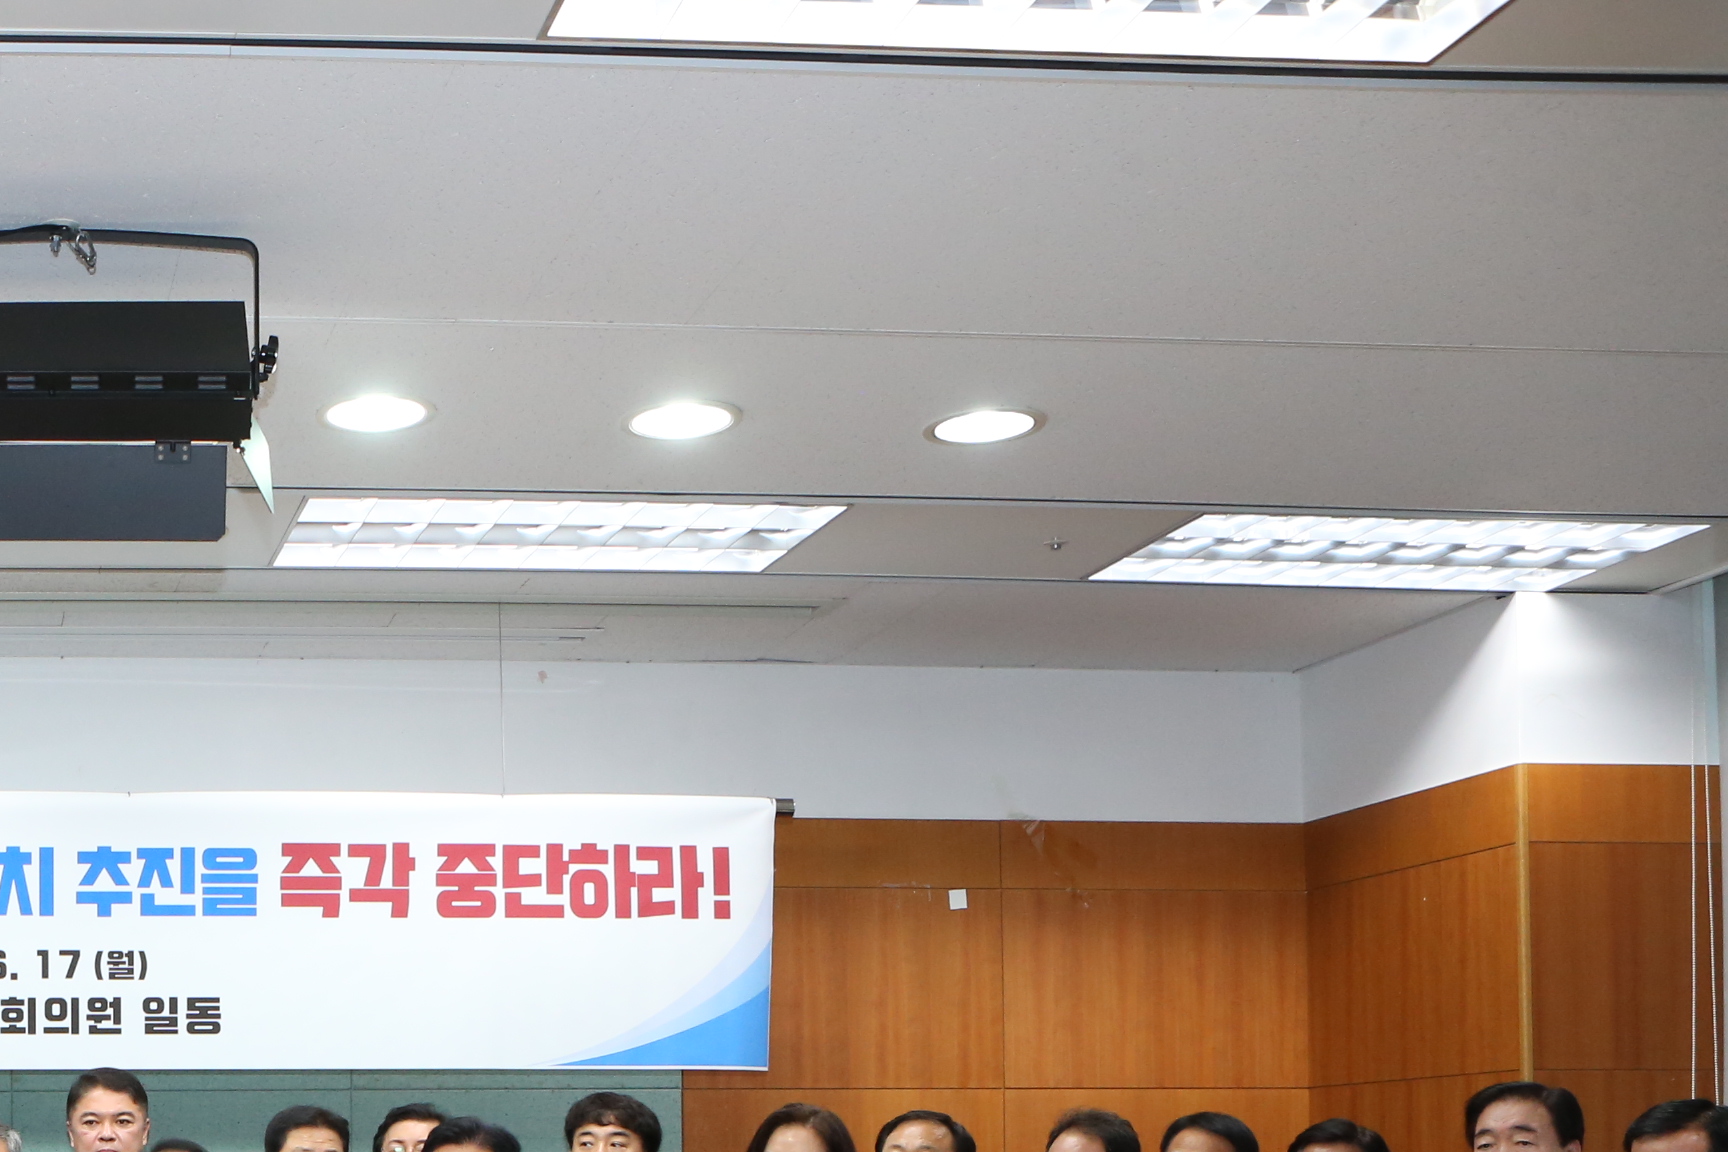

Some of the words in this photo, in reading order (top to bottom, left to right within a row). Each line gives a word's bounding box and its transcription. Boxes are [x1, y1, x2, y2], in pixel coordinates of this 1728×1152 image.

[75, 845, 259, 918] 추진을
[279, 842, 416, 919] 즉각
[435, 842, 731, 920] 중단하라!
[36, 949, 81, 980] 17
[94, 950, 148, 981] (월)
[142, 996, 222, 1035] 일동
